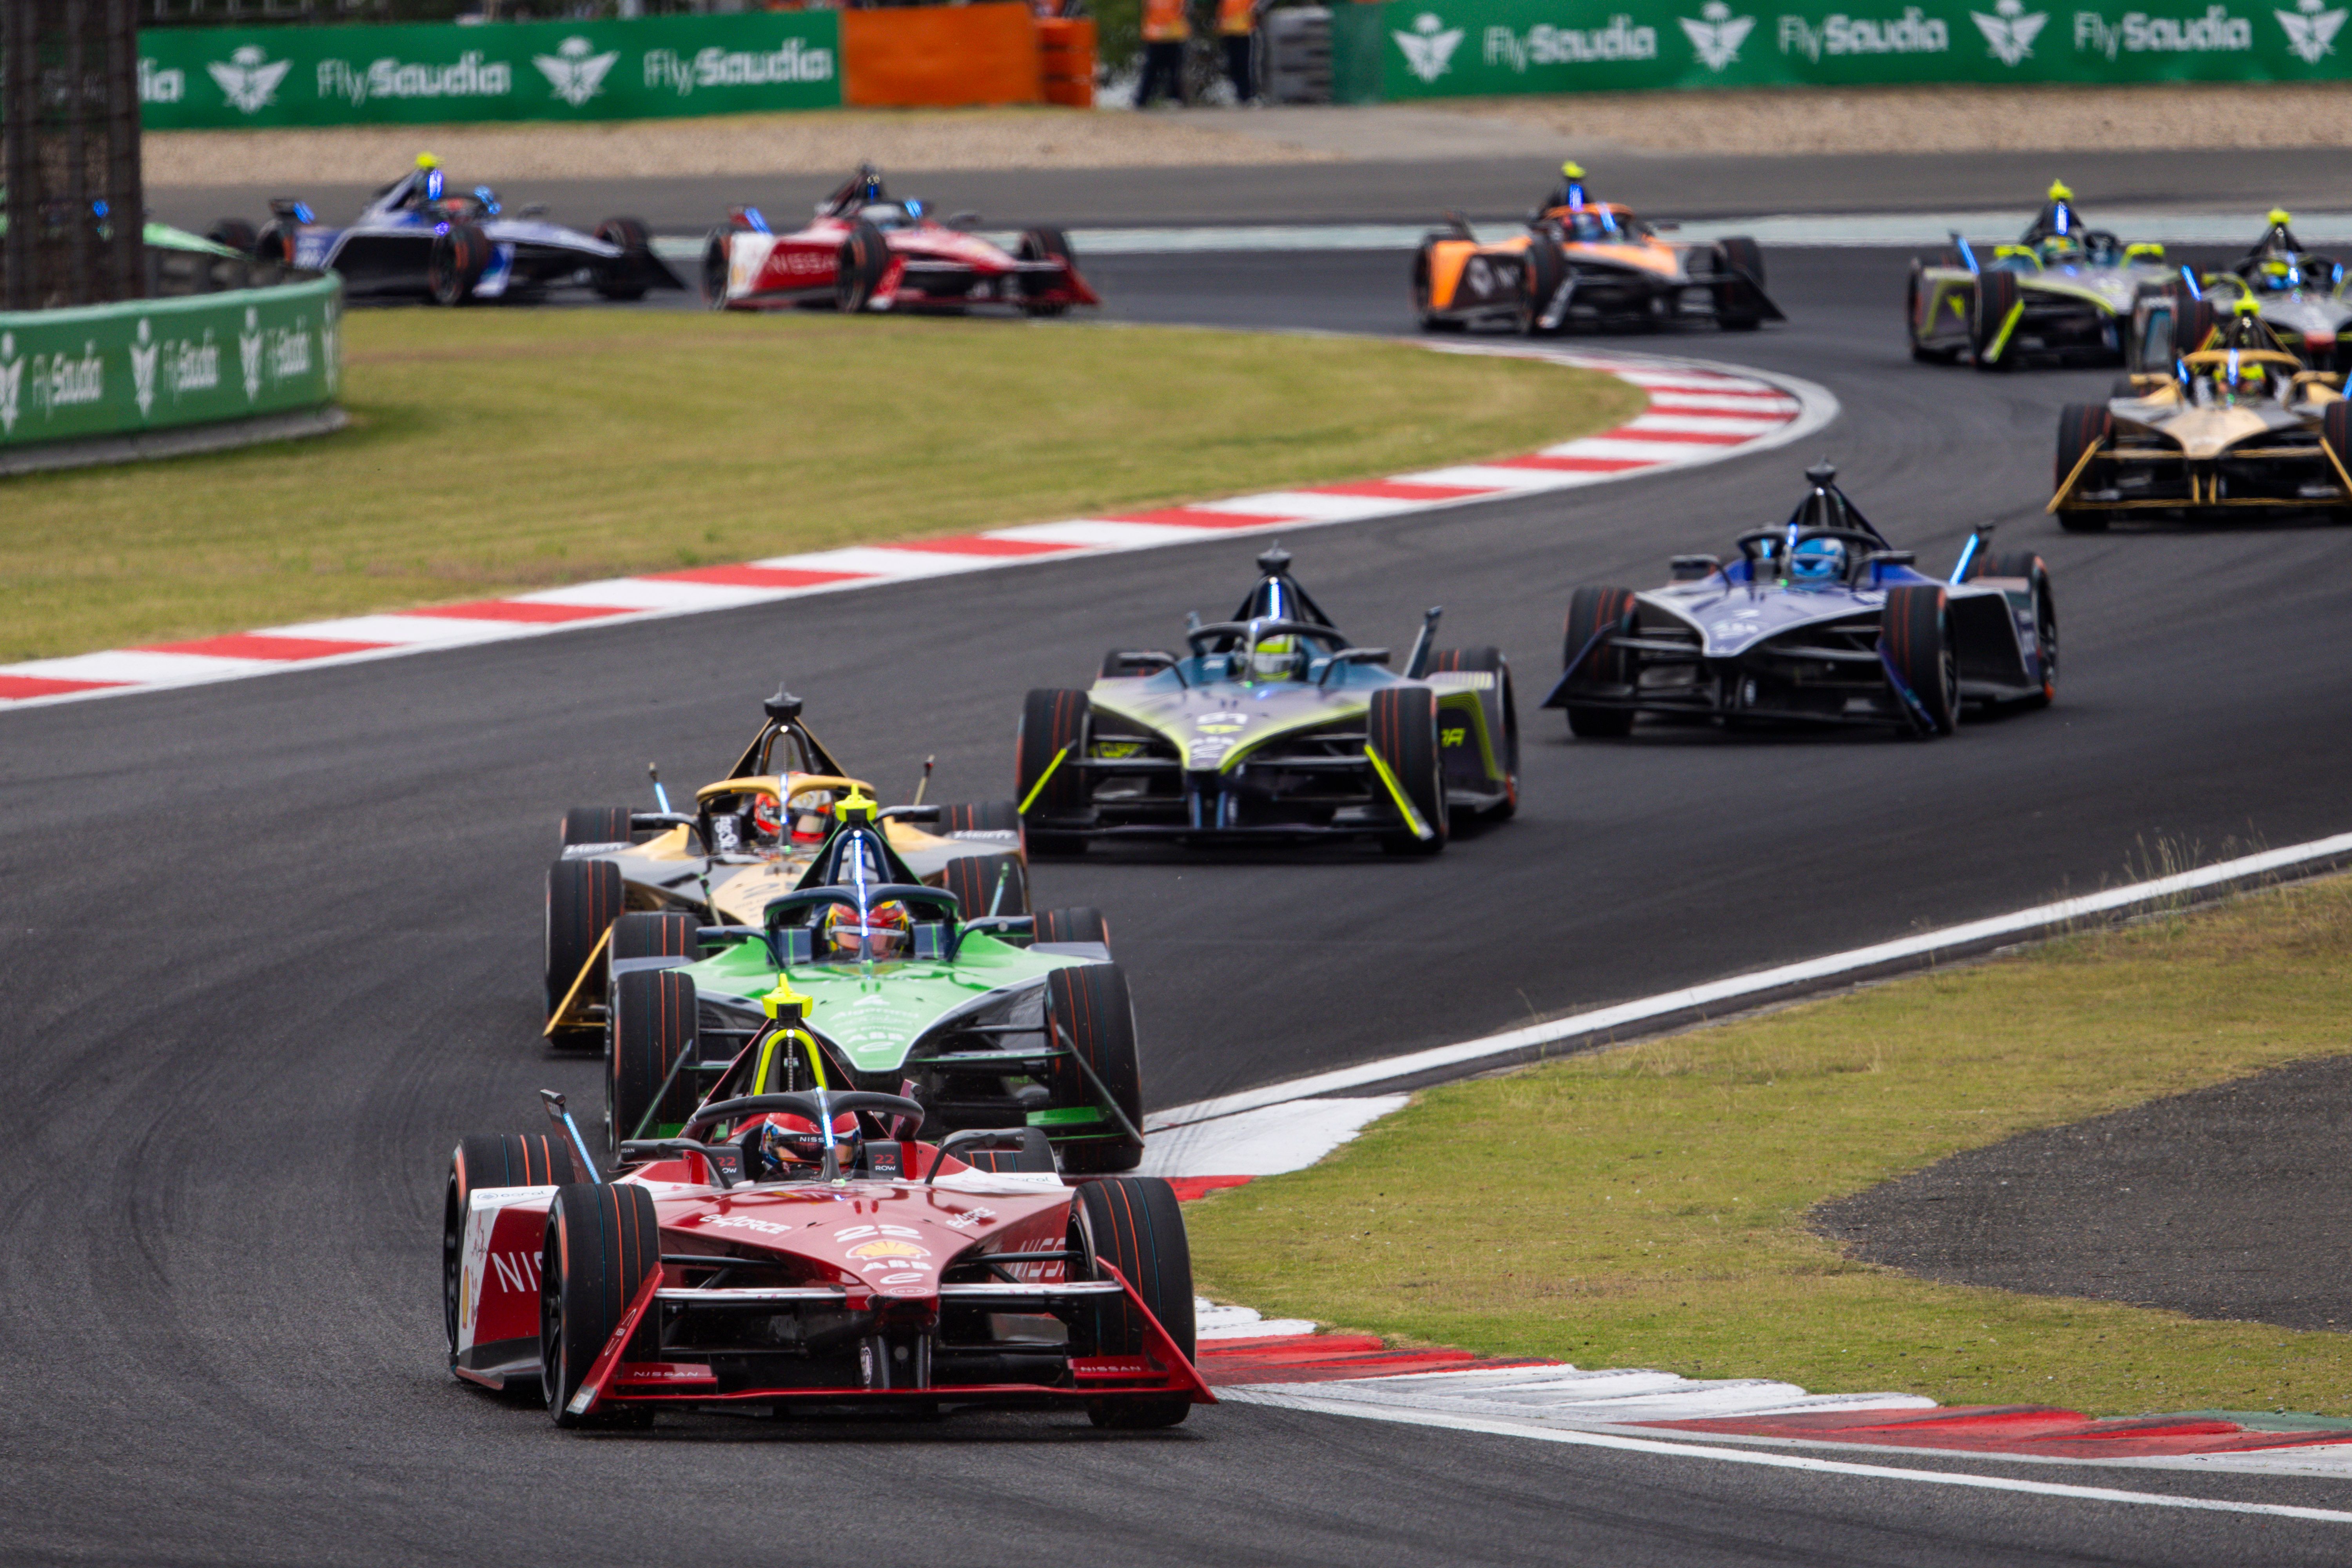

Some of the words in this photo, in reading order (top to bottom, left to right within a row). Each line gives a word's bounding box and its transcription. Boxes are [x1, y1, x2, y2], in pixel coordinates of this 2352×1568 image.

[1483, 14, 1657, 73] FlySaudia
[1777, 5, 1949, 64] FlySaudia
[138, 57, 185, 103] ia
[317, 50, 511, 107] FlySaudia
[643, 37, 833, 97] FlySaudia
[800, 1136, 838, 1144] NISSN
[874, 1154, 895, 1164] 22
[833, 1225, 923, 1243] 22
[862, 1260, 933, 1272] ABB
